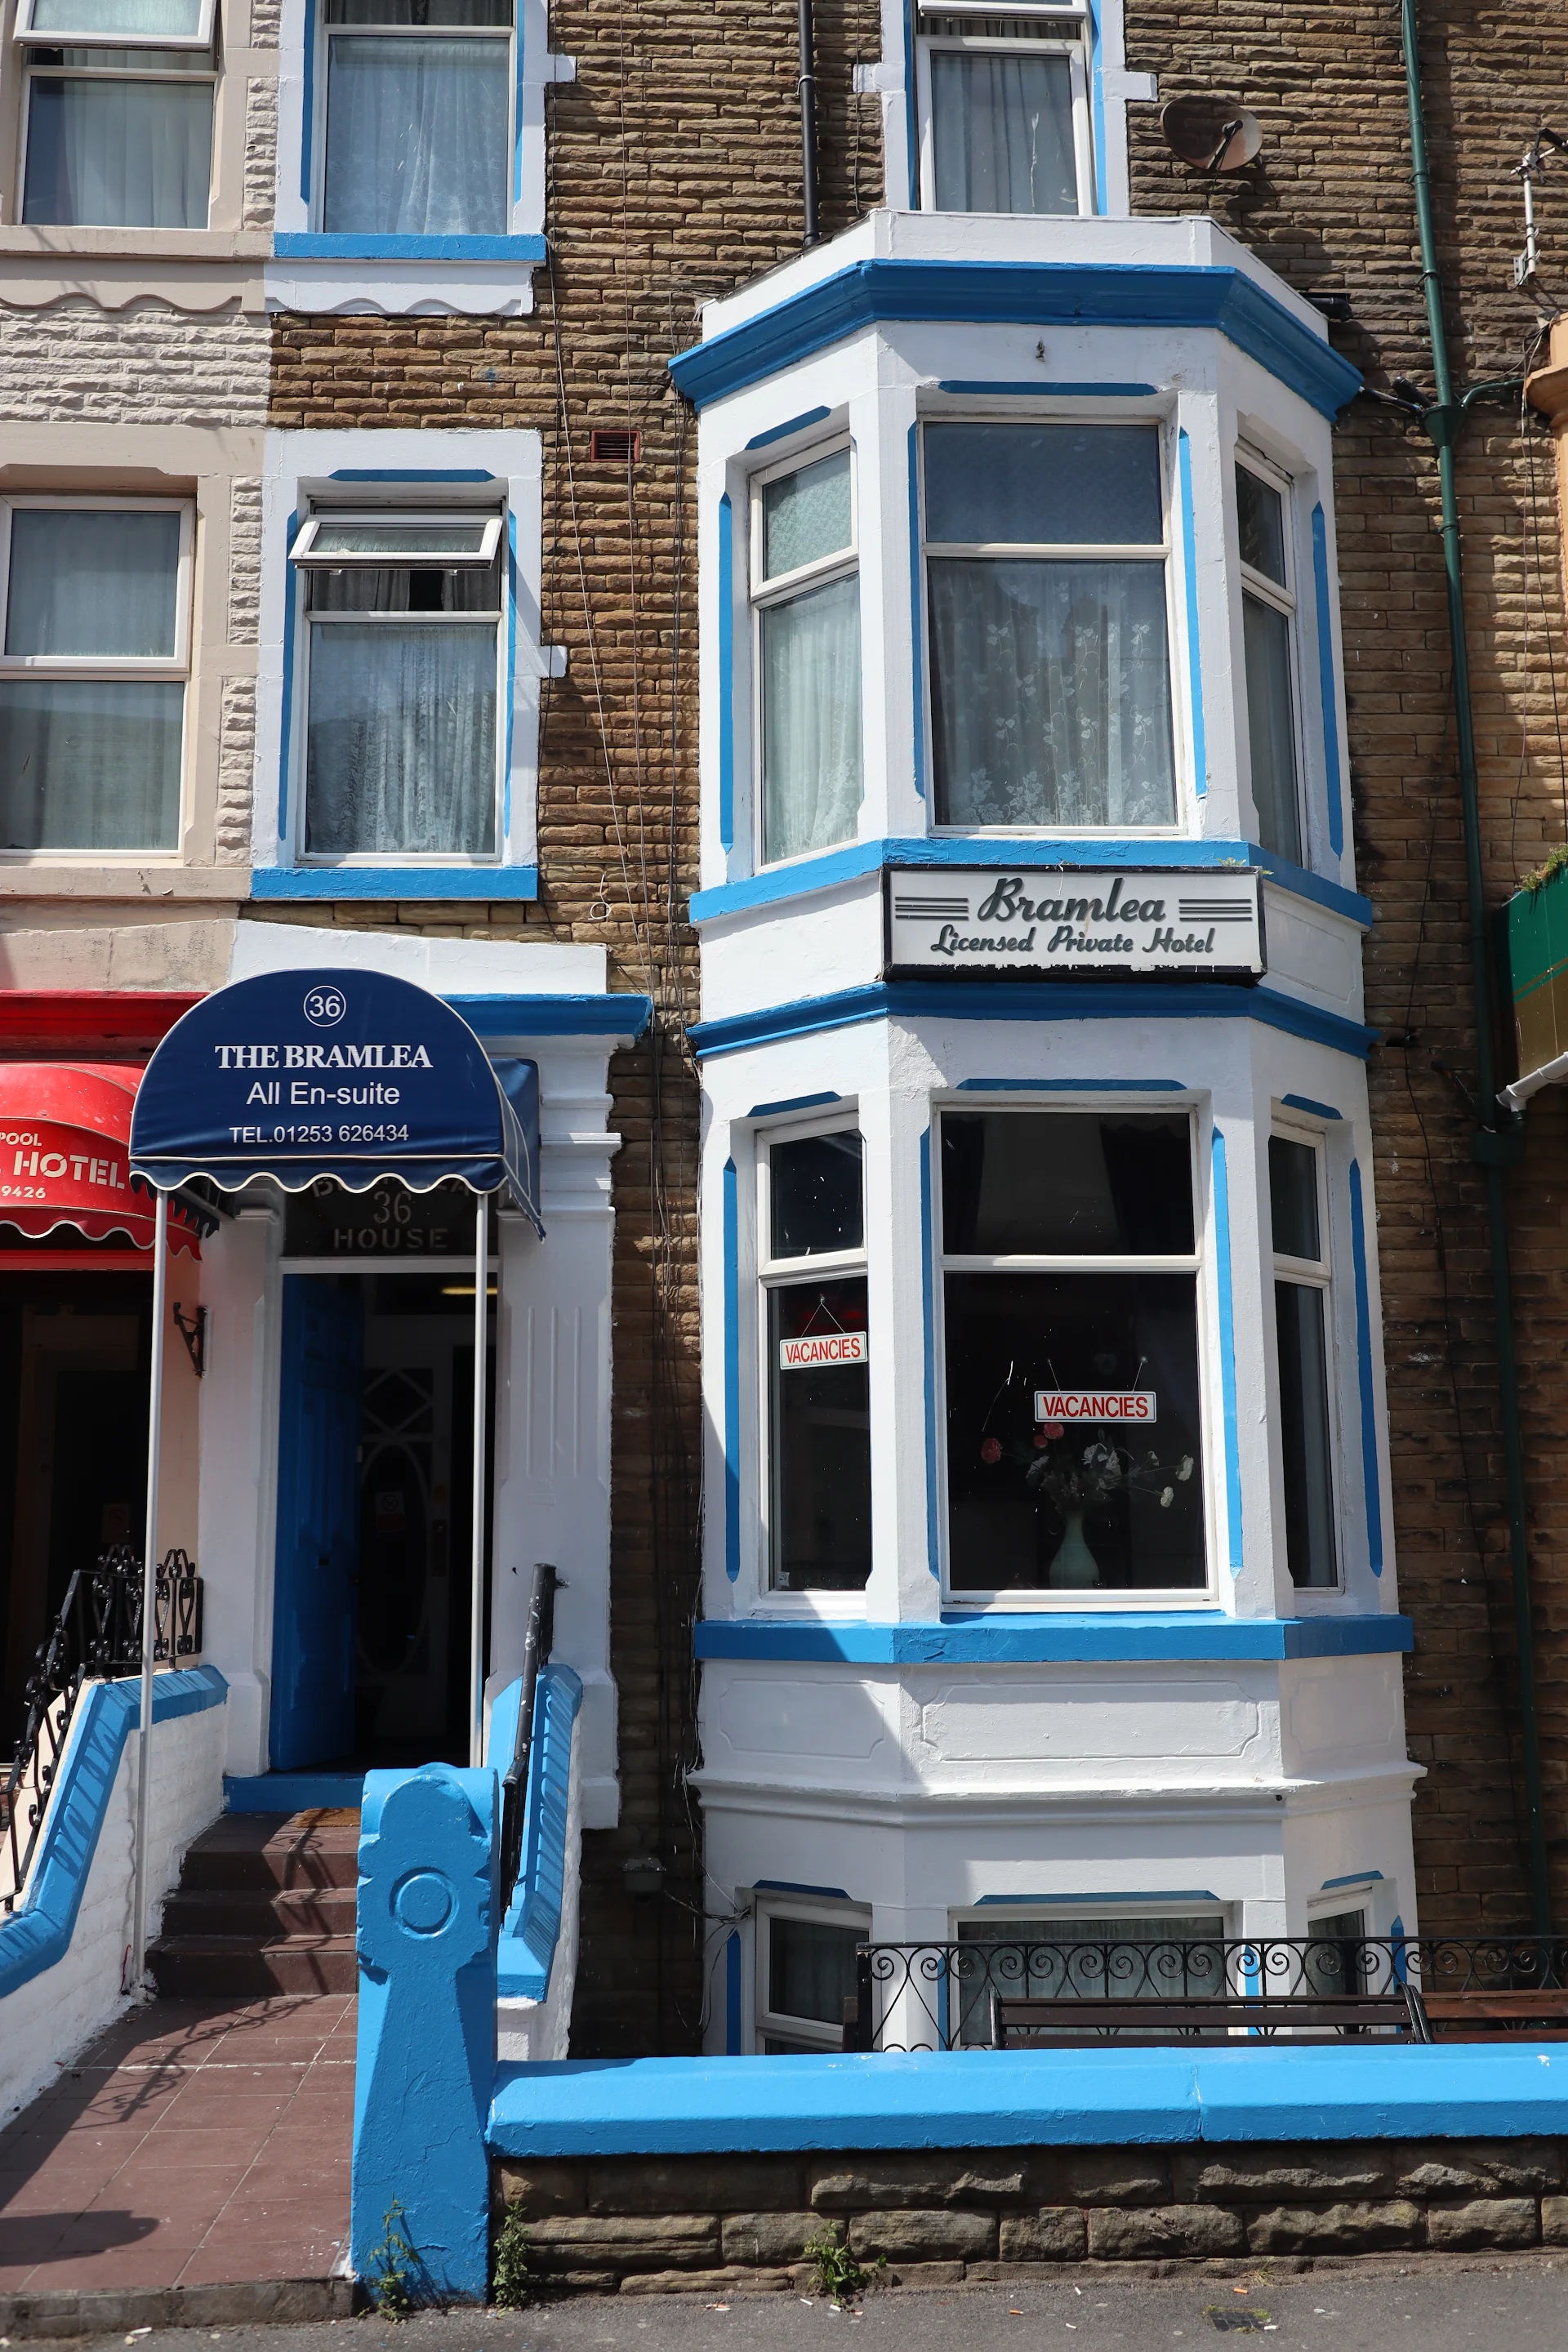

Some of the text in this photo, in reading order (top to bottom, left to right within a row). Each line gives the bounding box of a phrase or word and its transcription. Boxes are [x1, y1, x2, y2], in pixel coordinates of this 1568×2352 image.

[977, 877, 1166, 922] Bramlea
[930, 924, 1216, 955] Licensed Private Hotel
[309, 994, 340, 1018] 36
[215, 1045, 434, 1069] THE BRAMLEA
[247, 1081, 400, 1105] All En-suite
[229, 1124, 409, 1143] TEL.01253 626434
[13, 1151, 125, 1190] HOTEL
[1, 1185, 47, 1199] 9426
[373, 1191, 412, 1224] 36
[334, 1227, 448, 1249] HOUSE
[786, 1337, 861, 1364] VACANCIES
[1043, 1396, 1149, 1418] VACANCIES
